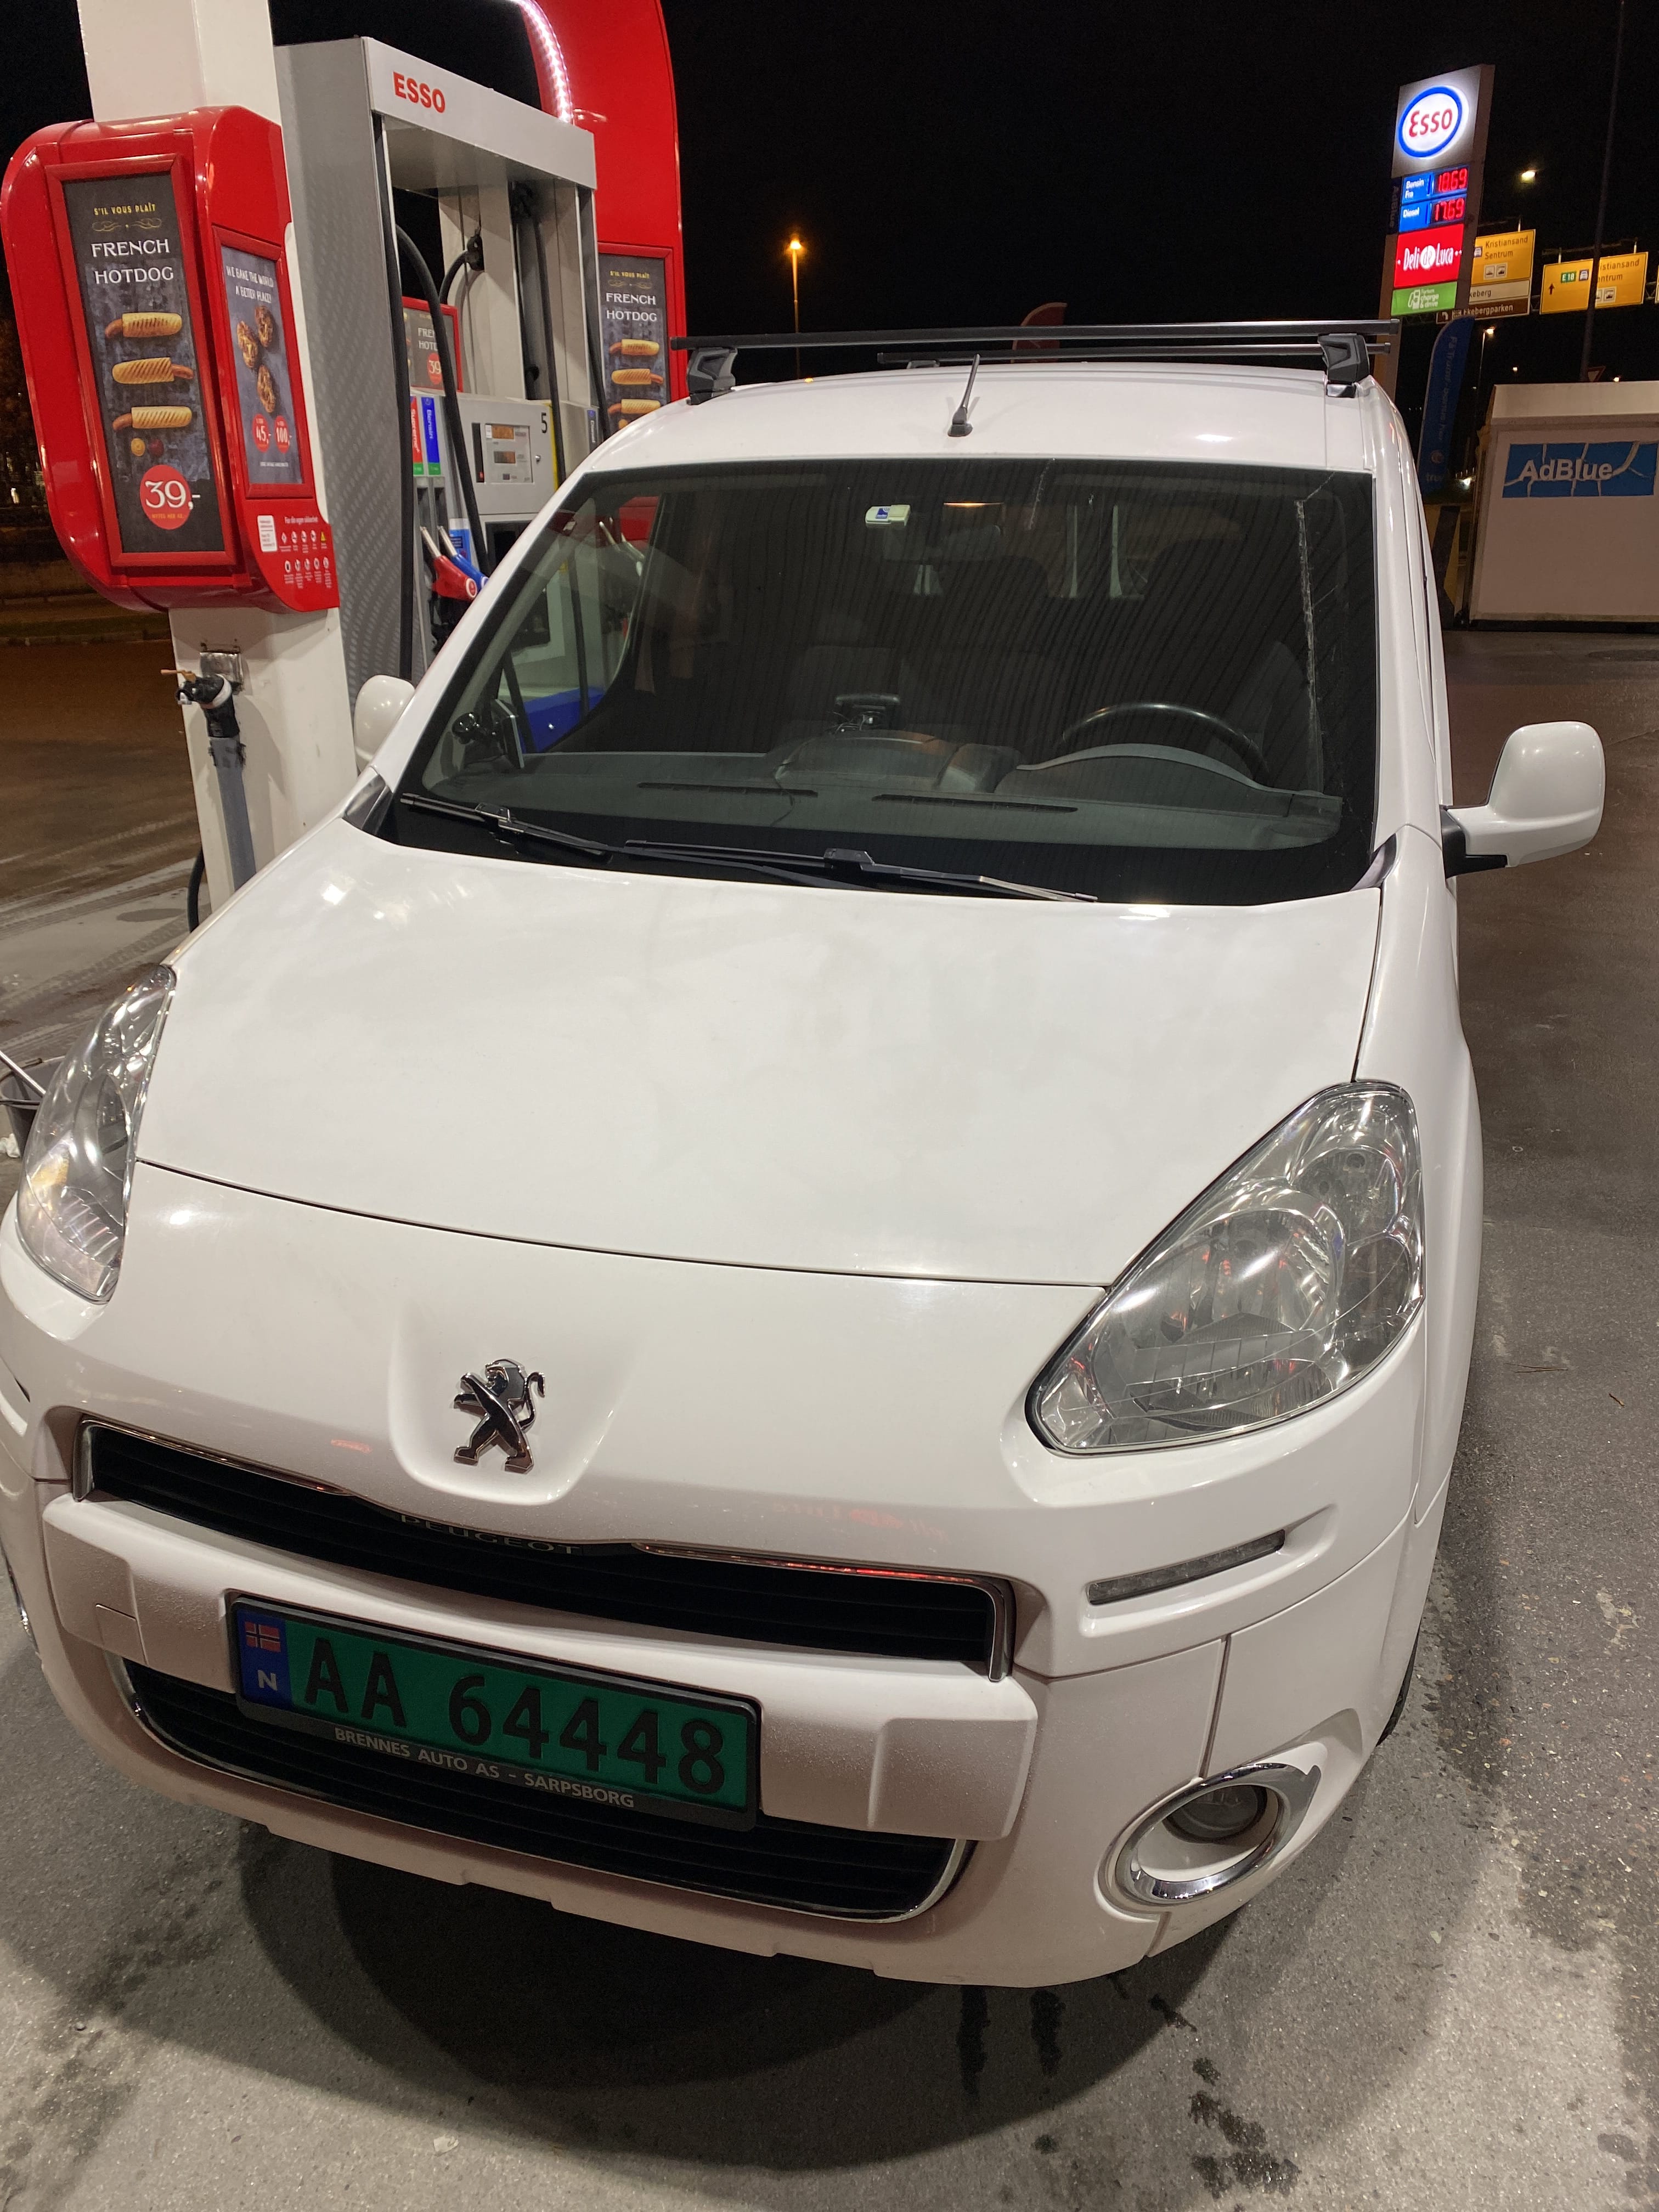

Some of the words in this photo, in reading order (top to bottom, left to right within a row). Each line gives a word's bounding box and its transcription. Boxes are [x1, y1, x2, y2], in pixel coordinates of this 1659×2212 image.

[393, 71, 445, 114] ESSO
[1406, 178, 1424, 189] Bensin
[111, 206, 132, 215] VOUS
[135, 202, 156, 212] PLAÎT
[1403, 207, 1420, 218] Diesel
[91, 239, 170, 257] FRENCH
[1486, 235, 1528, 249] Kristiansand
[1403, 246, 1420, 271] Deli
[1435, 242, 1454, 267] Luca
[1485, 250, 1514, 260] Sentrum
[1600, 259, 1640, 271] istiansand
[94, 266, 174, 284] HOTDOG
[606, 292, 656, 305] FRENCH
[606, 310, 657, 322] HOTDOG
[541, 412, 548, 433] 5
[1519, 459, 1613, 481] AdBlue
[145, 480, 200, 510] 39,-
[258, 1669, 277, 1691] N
[304, 1637, 407, 1729] AA
[448, 1675, 725, 1795] 64448
[335, 1726, 410, 1758] BRENNES
[418, 1747, 469, 1772] AUTO
[476, 1762, 500, 1779] AS
[524, 1772, 635, 1809] SARPSBORG
